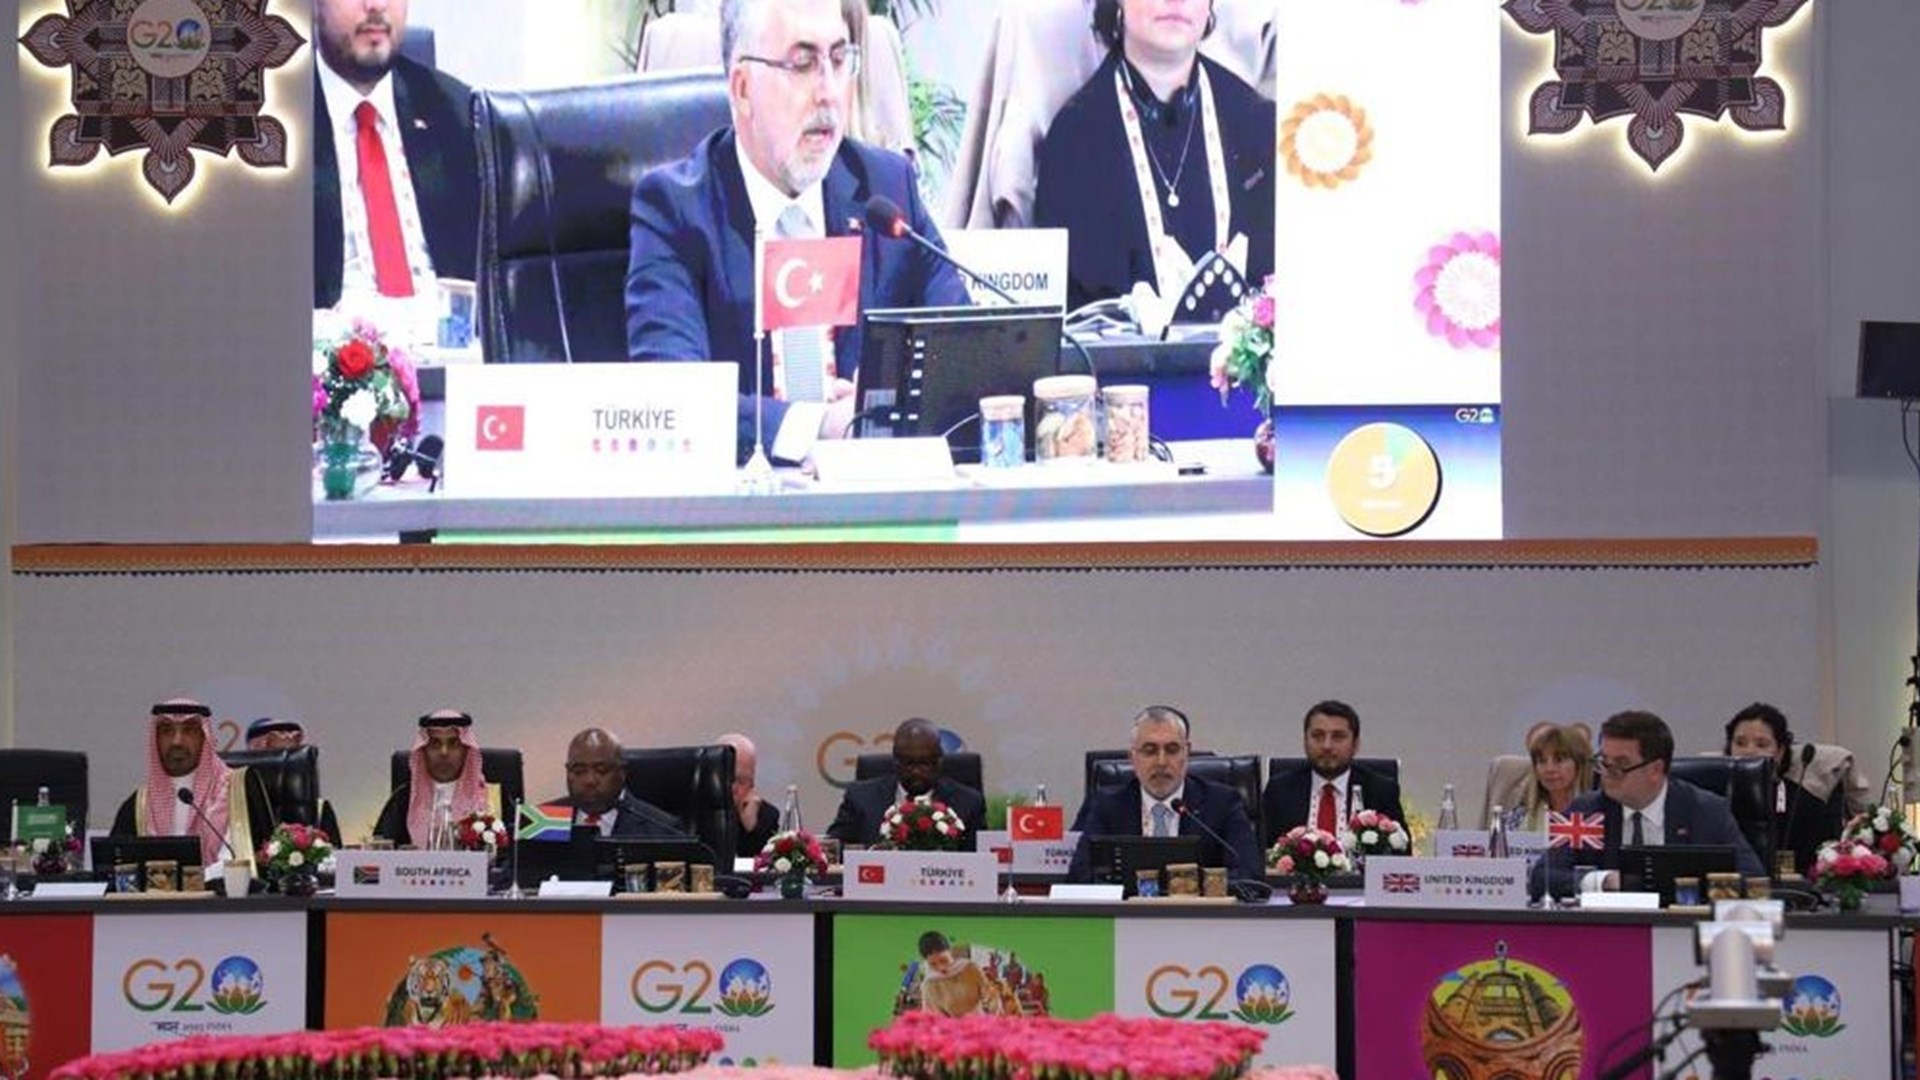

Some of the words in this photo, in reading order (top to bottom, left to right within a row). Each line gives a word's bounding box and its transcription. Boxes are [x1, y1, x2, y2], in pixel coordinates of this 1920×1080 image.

[130, 18, 205, 50] G20
[971, 271, 1048, 291] KINGDOM
[593, 405, 676, 430] TÜRKİYE
[1455, 407, 1494, 423] G20
[395, 867, 431, 877] SOUTH
[433, 867, 471, 877] AFRICA
[921, 866, 965, 878] TÜRKİYE
[1424, 874, 1462, 885] UNITED
[1465, 875, 1515, 886] KINGDOM
[122, 955, 267, 1015] G20
[631, 957, 775, 1017] G20
[1145, 963, 1295, 1024] G20
